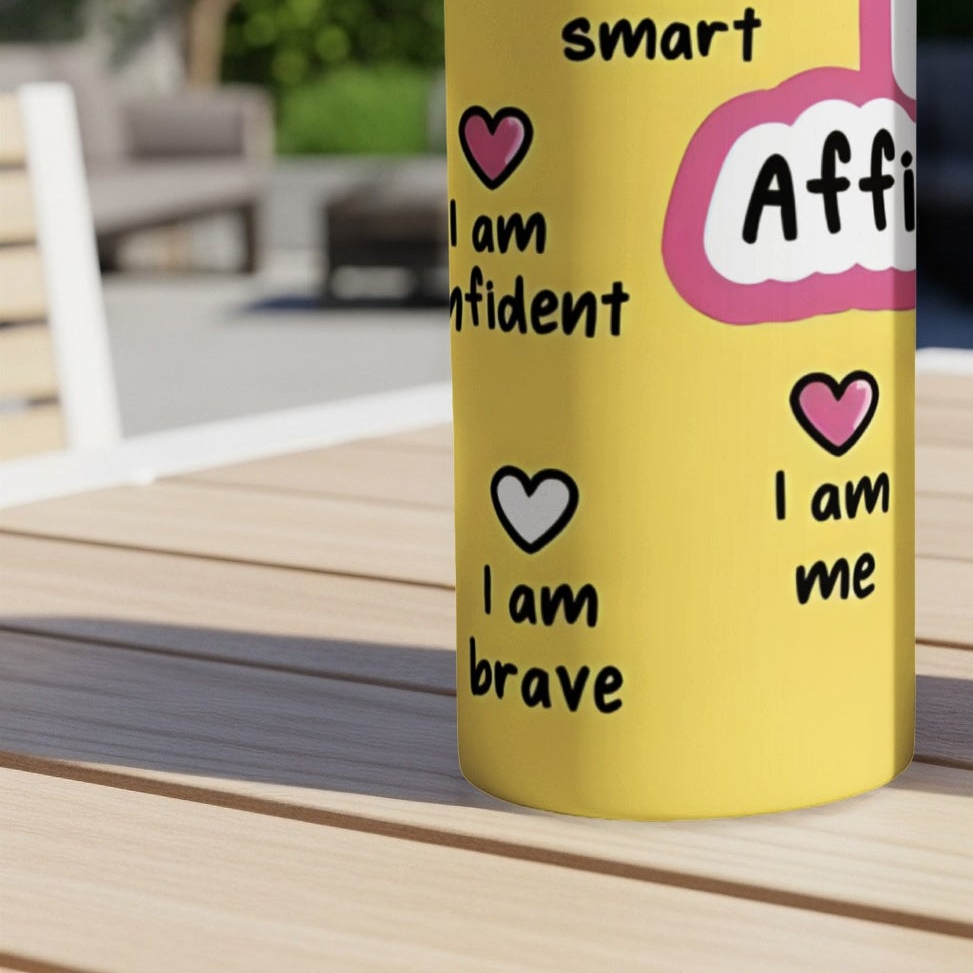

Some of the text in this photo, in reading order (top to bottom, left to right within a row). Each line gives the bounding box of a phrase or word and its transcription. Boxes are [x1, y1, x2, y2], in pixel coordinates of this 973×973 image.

[562, 8, 762, 62] smart
[742, 128, 915, 245] Affi
[471, 211, 547, 254] am
[776, 471, 890, 522] I am
[484, 564, 599, 628] I am
[796, 552, 876, 605] me
[469, 636, 624, 714] brave
